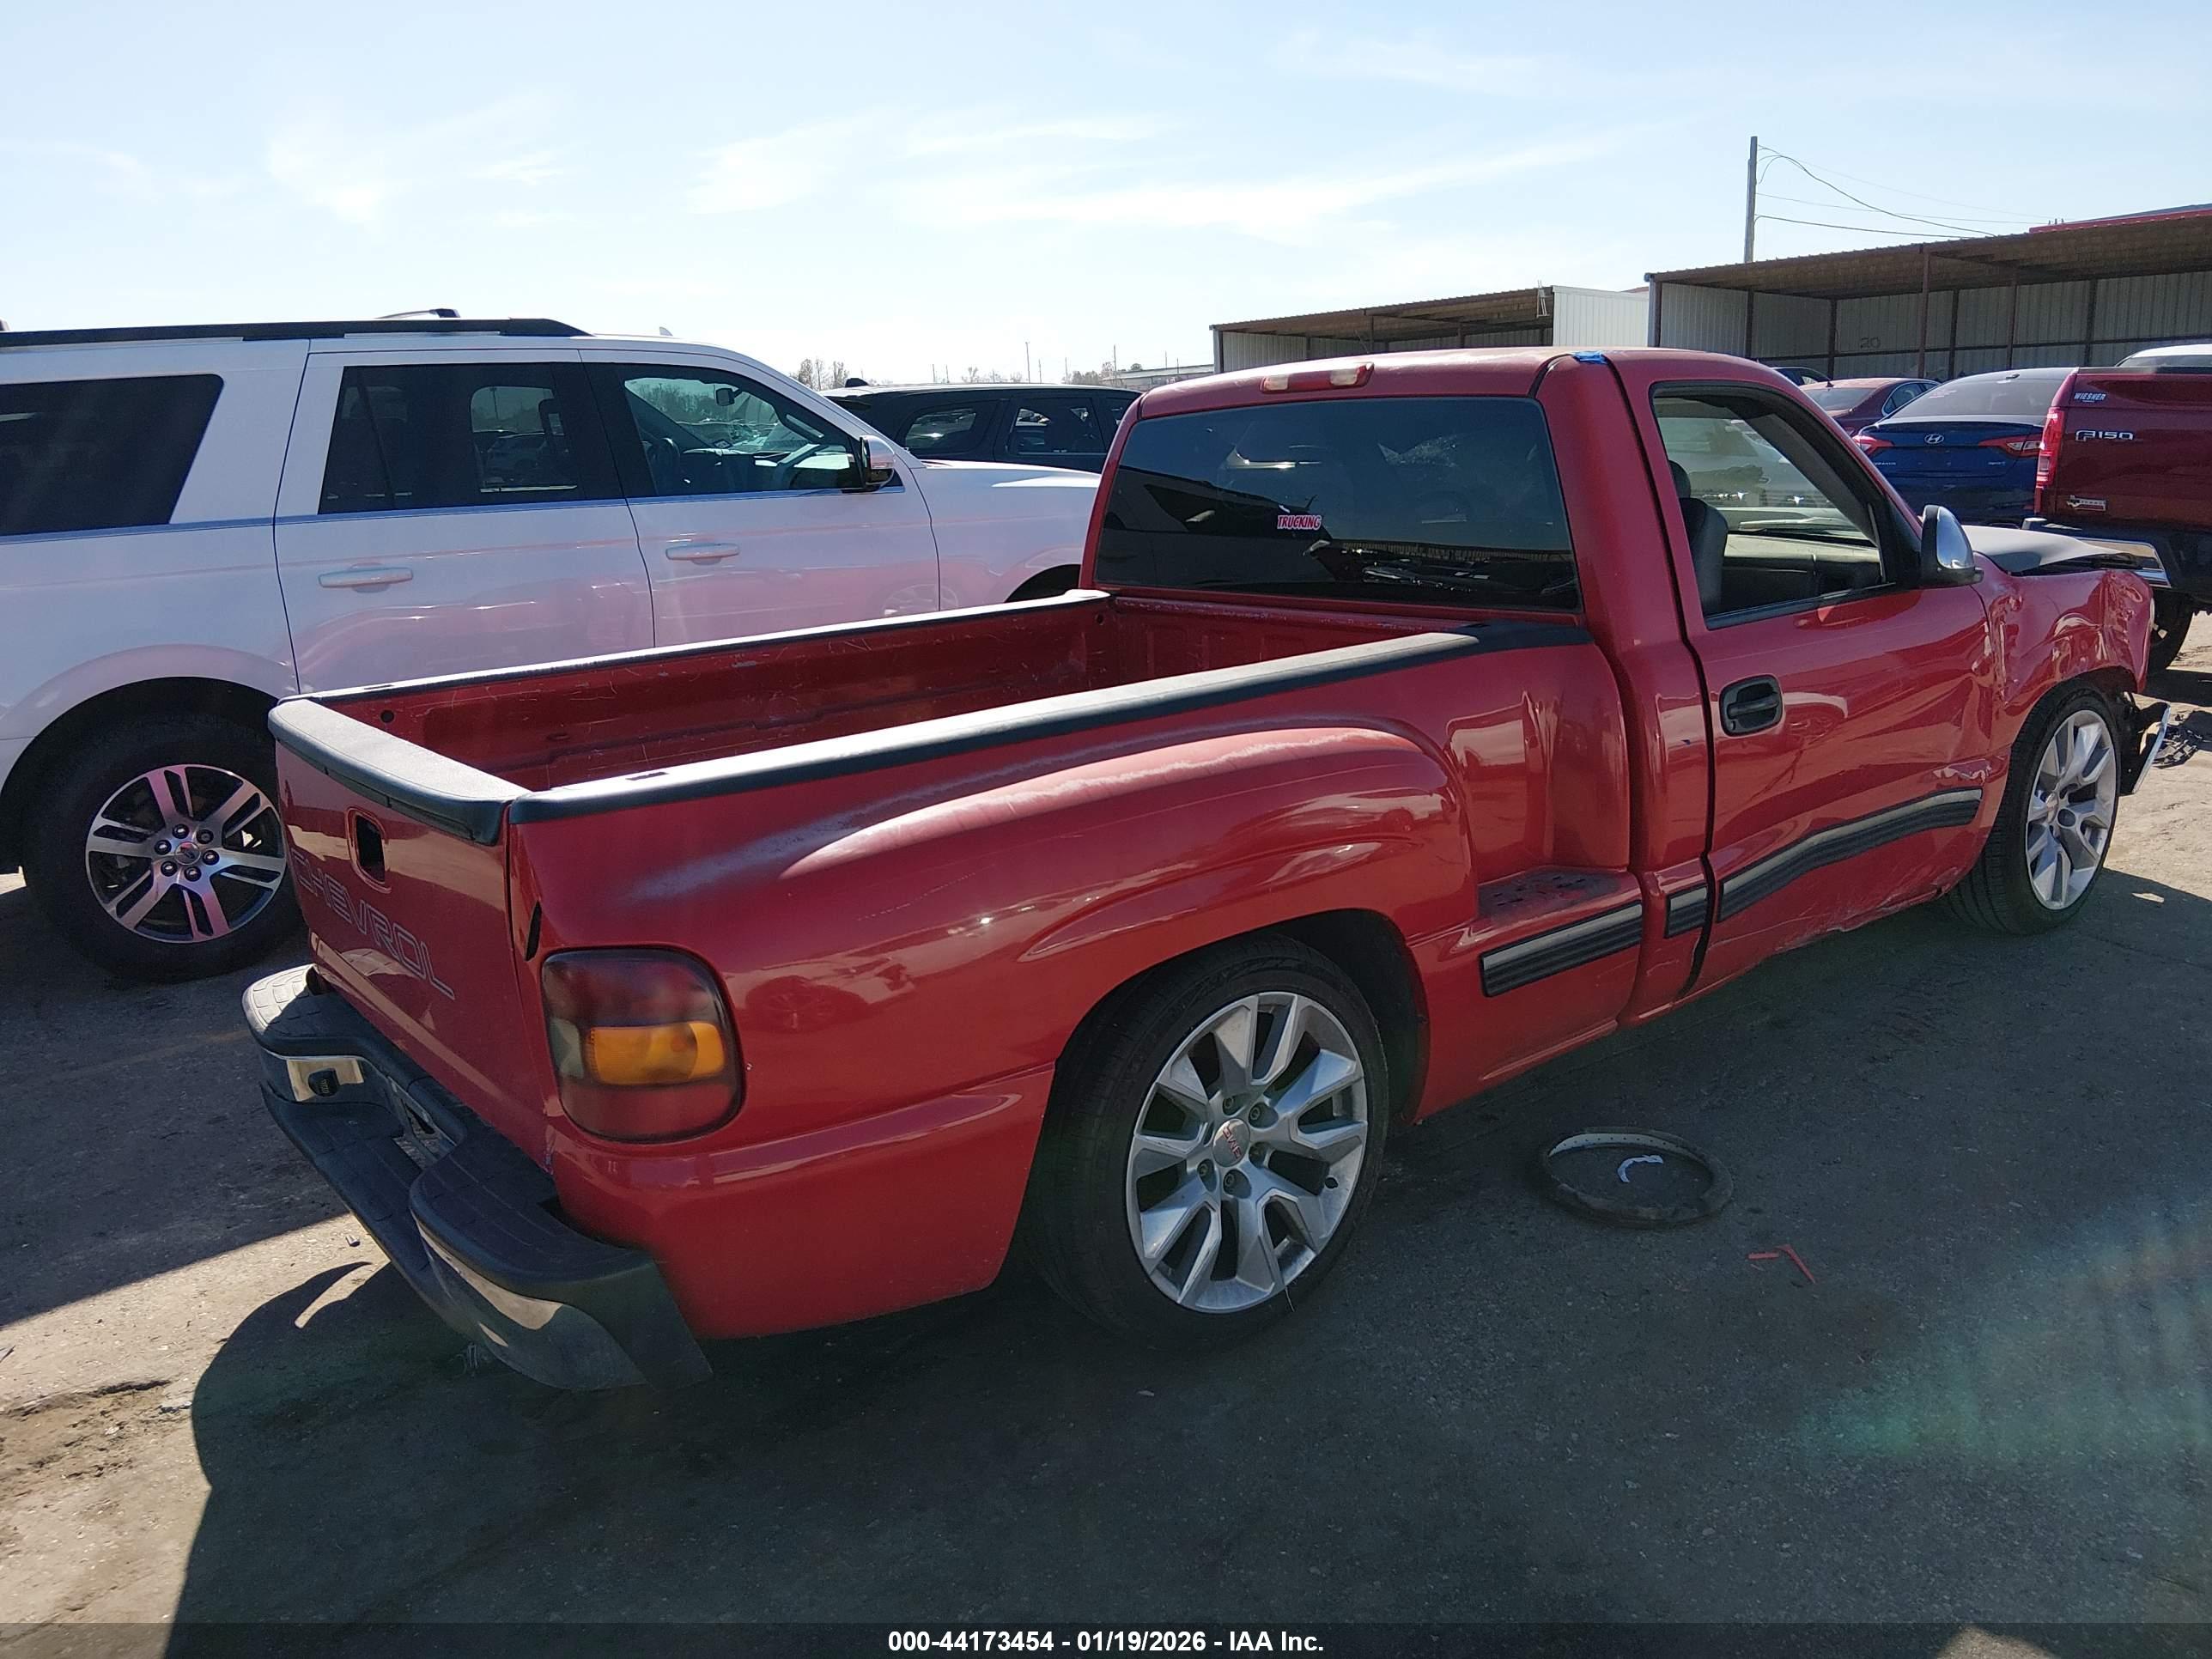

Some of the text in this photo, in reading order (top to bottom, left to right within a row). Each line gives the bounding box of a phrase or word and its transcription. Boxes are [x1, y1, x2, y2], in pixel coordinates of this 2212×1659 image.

[2074, 392, 2106, 401] WIESNER
[1278, 515, 1322, 530] TRUCKING
[290, 848, 454, 1000] CHEVROL
[1223, 1126, 1243, 1159] GMC
